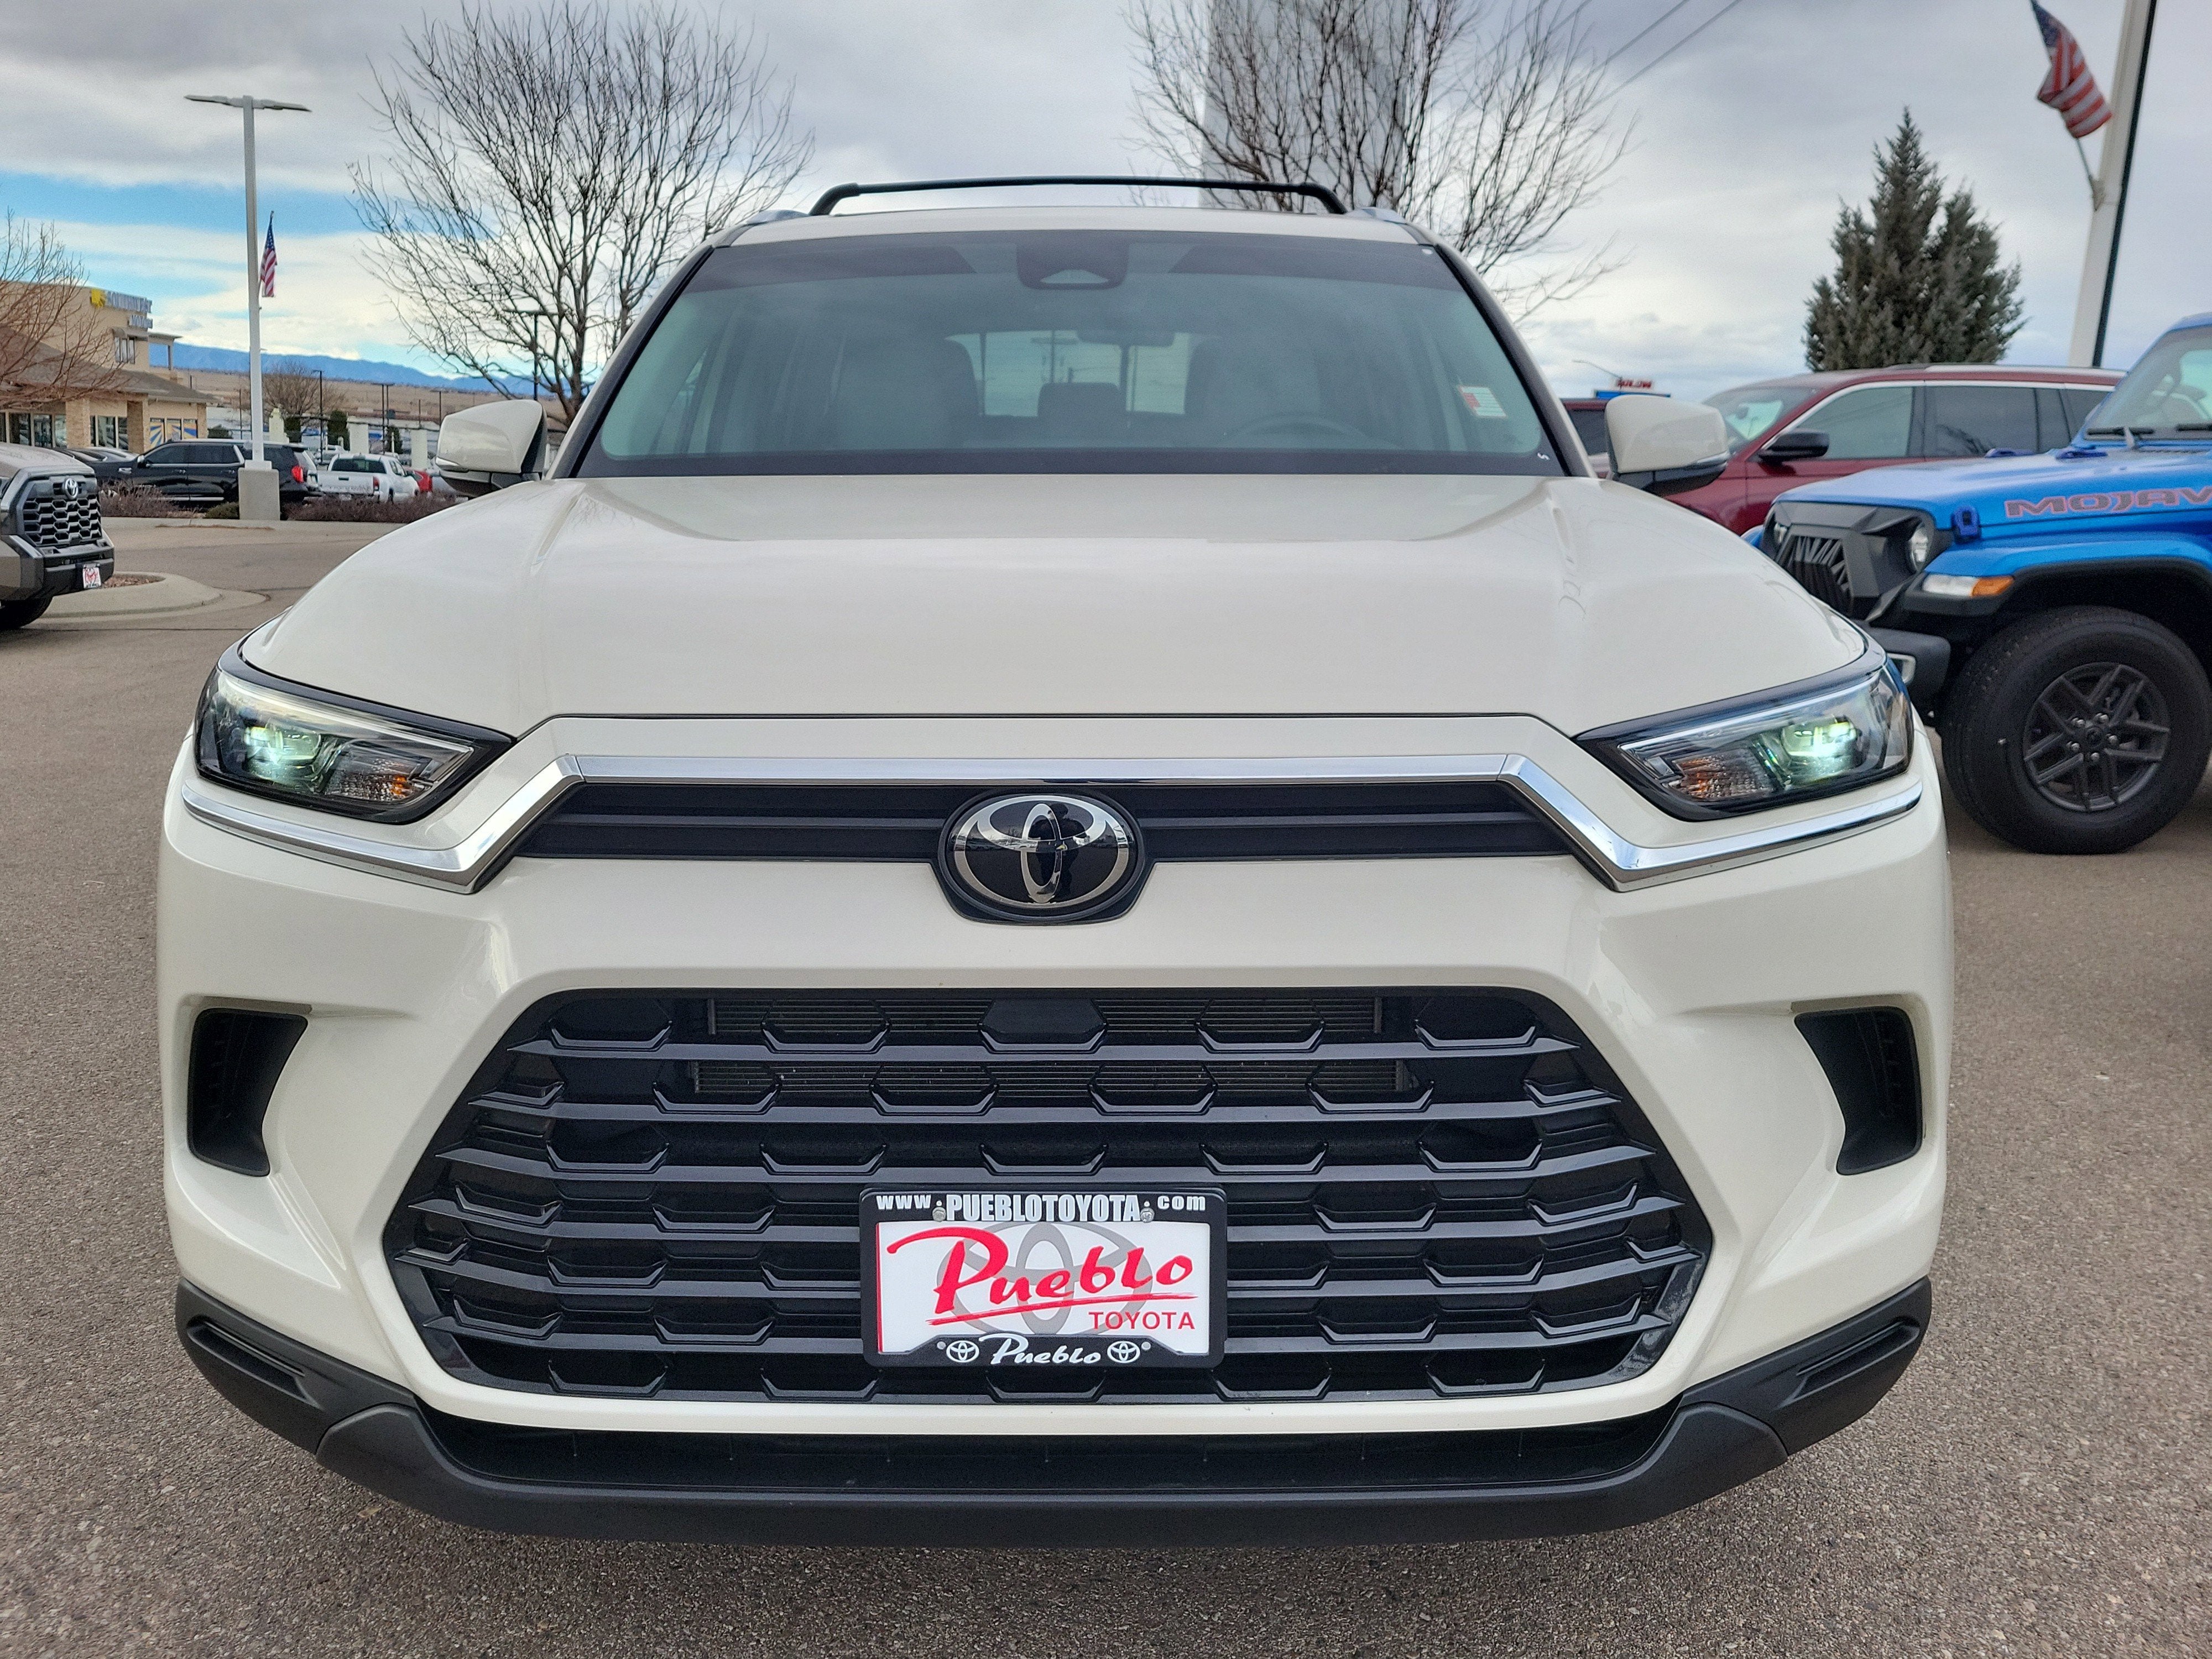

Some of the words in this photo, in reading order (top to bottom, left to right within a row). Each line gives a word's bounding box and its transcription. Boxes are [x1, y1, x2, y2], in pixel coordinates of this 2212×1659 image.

[887, 1226, 1193, 1314] Pueblo
[1088, 1311, 1196, 1329] TOYOTA
[978, 1333, 1101, 1365] Pueblo
